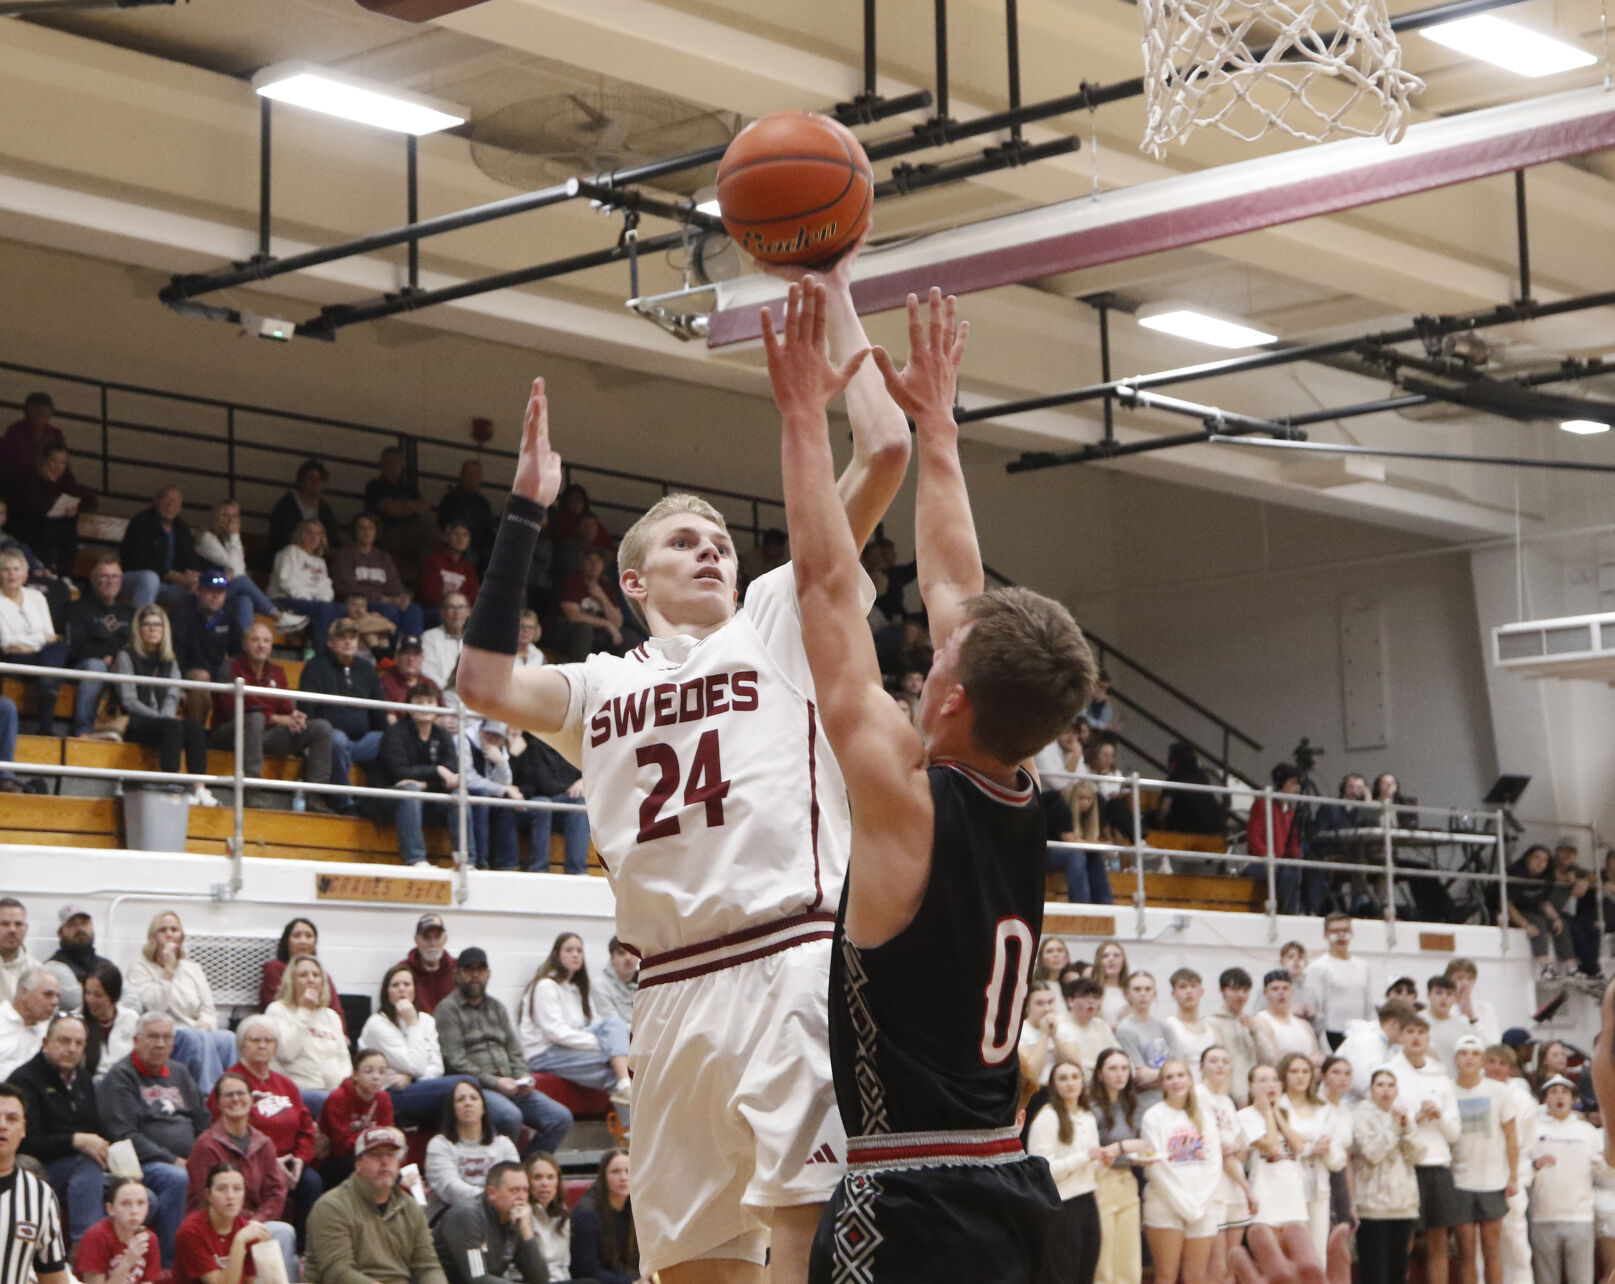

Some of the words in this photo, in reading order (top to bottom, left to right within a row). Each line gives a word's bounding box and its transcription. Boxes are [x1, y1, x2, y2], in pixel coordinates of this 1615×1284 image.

[590, 670, 758, 748] SWEDES
[635, 729, 731, 844] 24
[980, 914, 1035, 1068] 0
